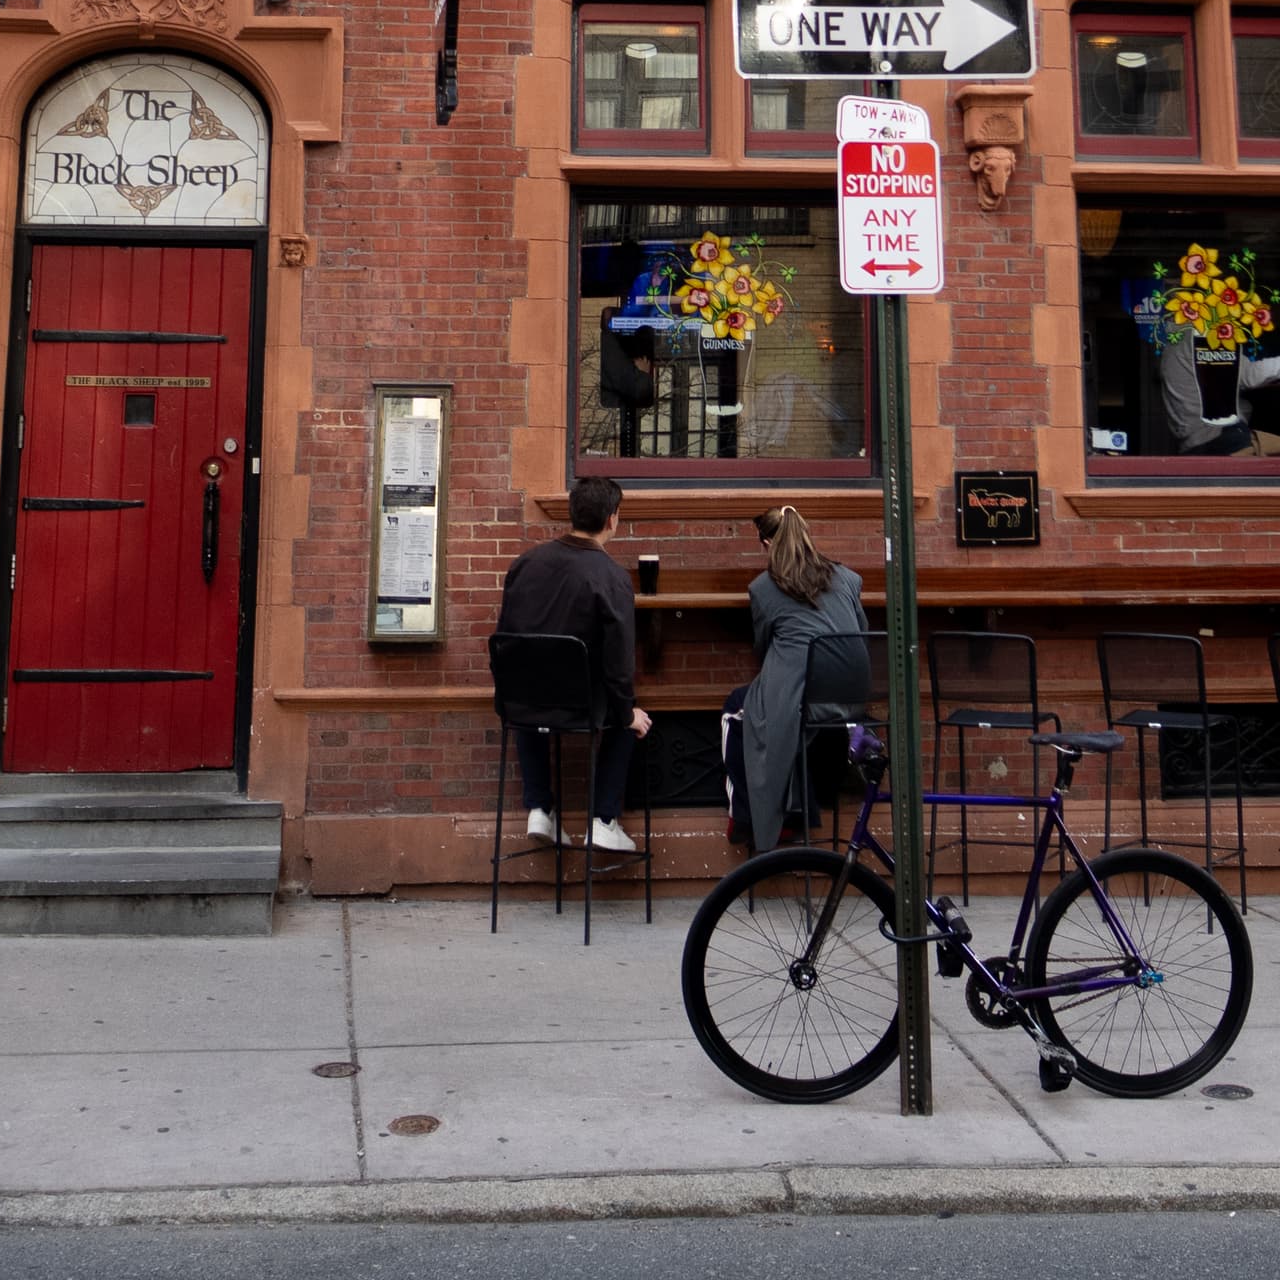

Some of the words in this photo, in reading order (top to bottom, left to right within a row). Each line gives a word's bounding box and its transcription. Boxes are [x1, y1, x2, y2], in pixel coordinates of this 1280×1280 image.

[769, 10, 847, 47] ONE
[861, 11, 942, 47] WAY
[123, 89, 178, 121] The
[854, 105, 879, 120] TOW
[868, 128, 907, 139] ZNE
[871, 144, 906, 173] NO
[53, 152, 134, 186] Black
[147, 154, 239, 195] Sheep
[846, 174, 933, 195] STOPPING
[864, 209, 918, 227] ANY
[862, 233, 920, 253] TIME
[702, 338, 745, 351] GUINNESS
[1196, 350, 1236, 361] GUINNESS
[71, 376, 91, 385] THE
[95, 377, 129, 386] BLACK
[133, 378, 164, 386] SHEEP
